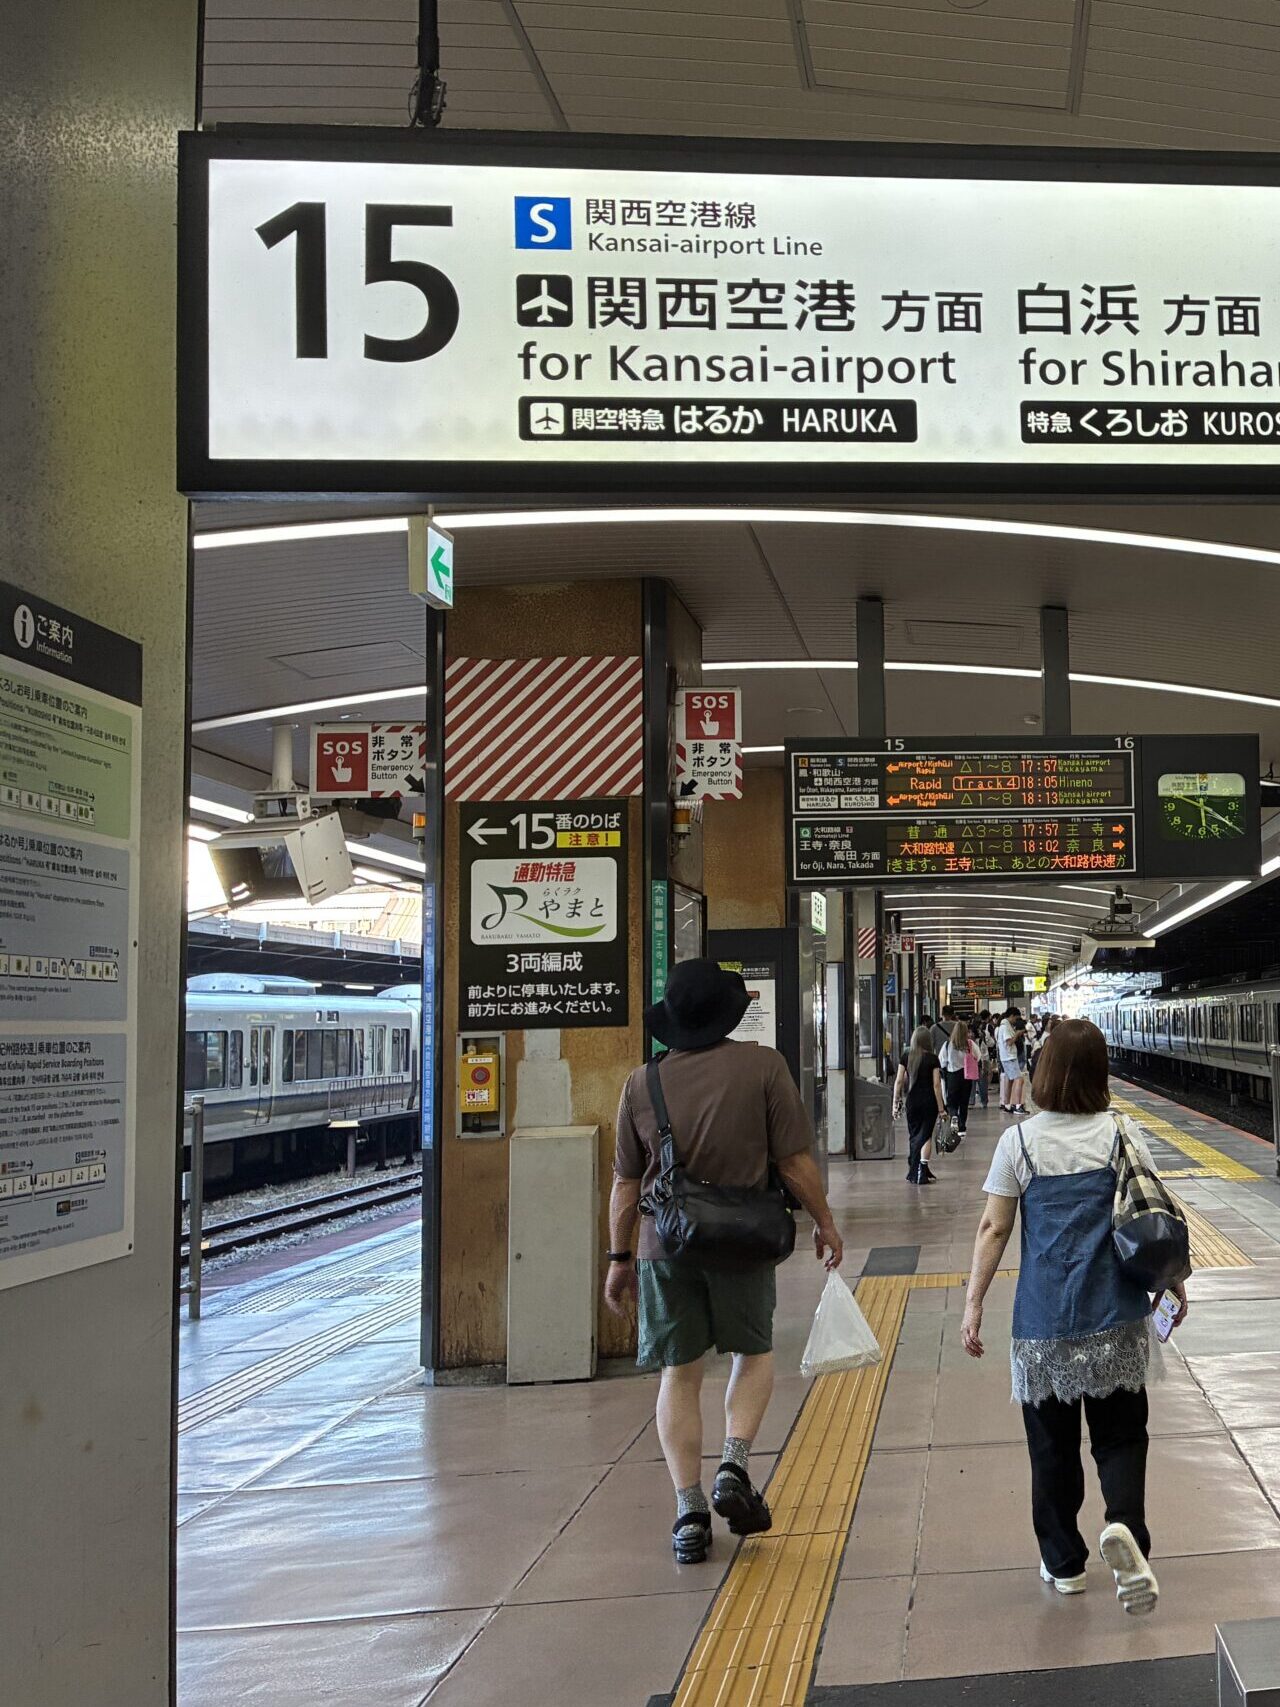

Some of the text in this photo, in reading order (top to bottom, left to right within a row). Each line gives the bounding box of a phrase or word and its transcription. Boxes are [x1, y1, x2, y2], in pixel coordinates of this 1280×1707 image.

[586, 199, 756, 230] 関西空港線
[530, 203, 556, 244] S
[588, 232, 823, 258] Kansai-airport Line
[255, 201, 460, 363] 15
[587, 276, 983, 335] 関西空港 方面
[1017, 282, 1262, 338] 白浜 方面
[518, 341, 957, 393] for Kansai-airport
[1019, 347, 1088, 386] for
[572, 405, 897, 435] 関空特急 はるか HARUKA
[1027, 411, 1073, 435] 特急
[1079, 408, 1188, 439] くろしお
[37, 614, 74, 649] ご案内
[36, 640, 73, 665] Information
[692, 696, 728, 709] SOS
[323, 741, 362, 755] SOS
[372, 735, 413, 748] 非常
[692, 742, 731, 754] 非常
[884, 738, 905, 751] 15
[1114, 736, 1135, 749] 16
[372, 749, 413, 761] ボタン
[371, 763, 414, 772] Emergency
[692, 756, 731, 768] ボタン
[1020, 760, 1057, 773] 17:57
[371, 772, 397, 780] Button
[691, 769, 732, 777] Emergency
[707, 777, 732, 785] Button
[910, 777, 942, 790] Rapid
[1021, 776, 1058, 789] 18:05
[1059, 776, 1093, 788] Hineno
[1022, 792, 1058, 805] 18:13
[1167, 802, 1176, 812] 9
[1173, 816, 1181, 825] 8
[510, 812, 621, 850] 15 番のりば
[1022, 823, 1059, 837] 17:57
[1185, 824, 1193, 833] 7
[1198, 826, 1206, 836] 6
[900, 841, 955, 855] 大和路快速
[1022, 840, 1059, 853] 18:02
[512, 861, 577, 883] 通勤特急
[538, 897, 604, 920] やまと
[506, 951, 583, 973] 3両編成
[468, 981, 621, 1000] 前よりに停車いたします。
[468, 1000, 612, 1018] 前方にお進みください。
